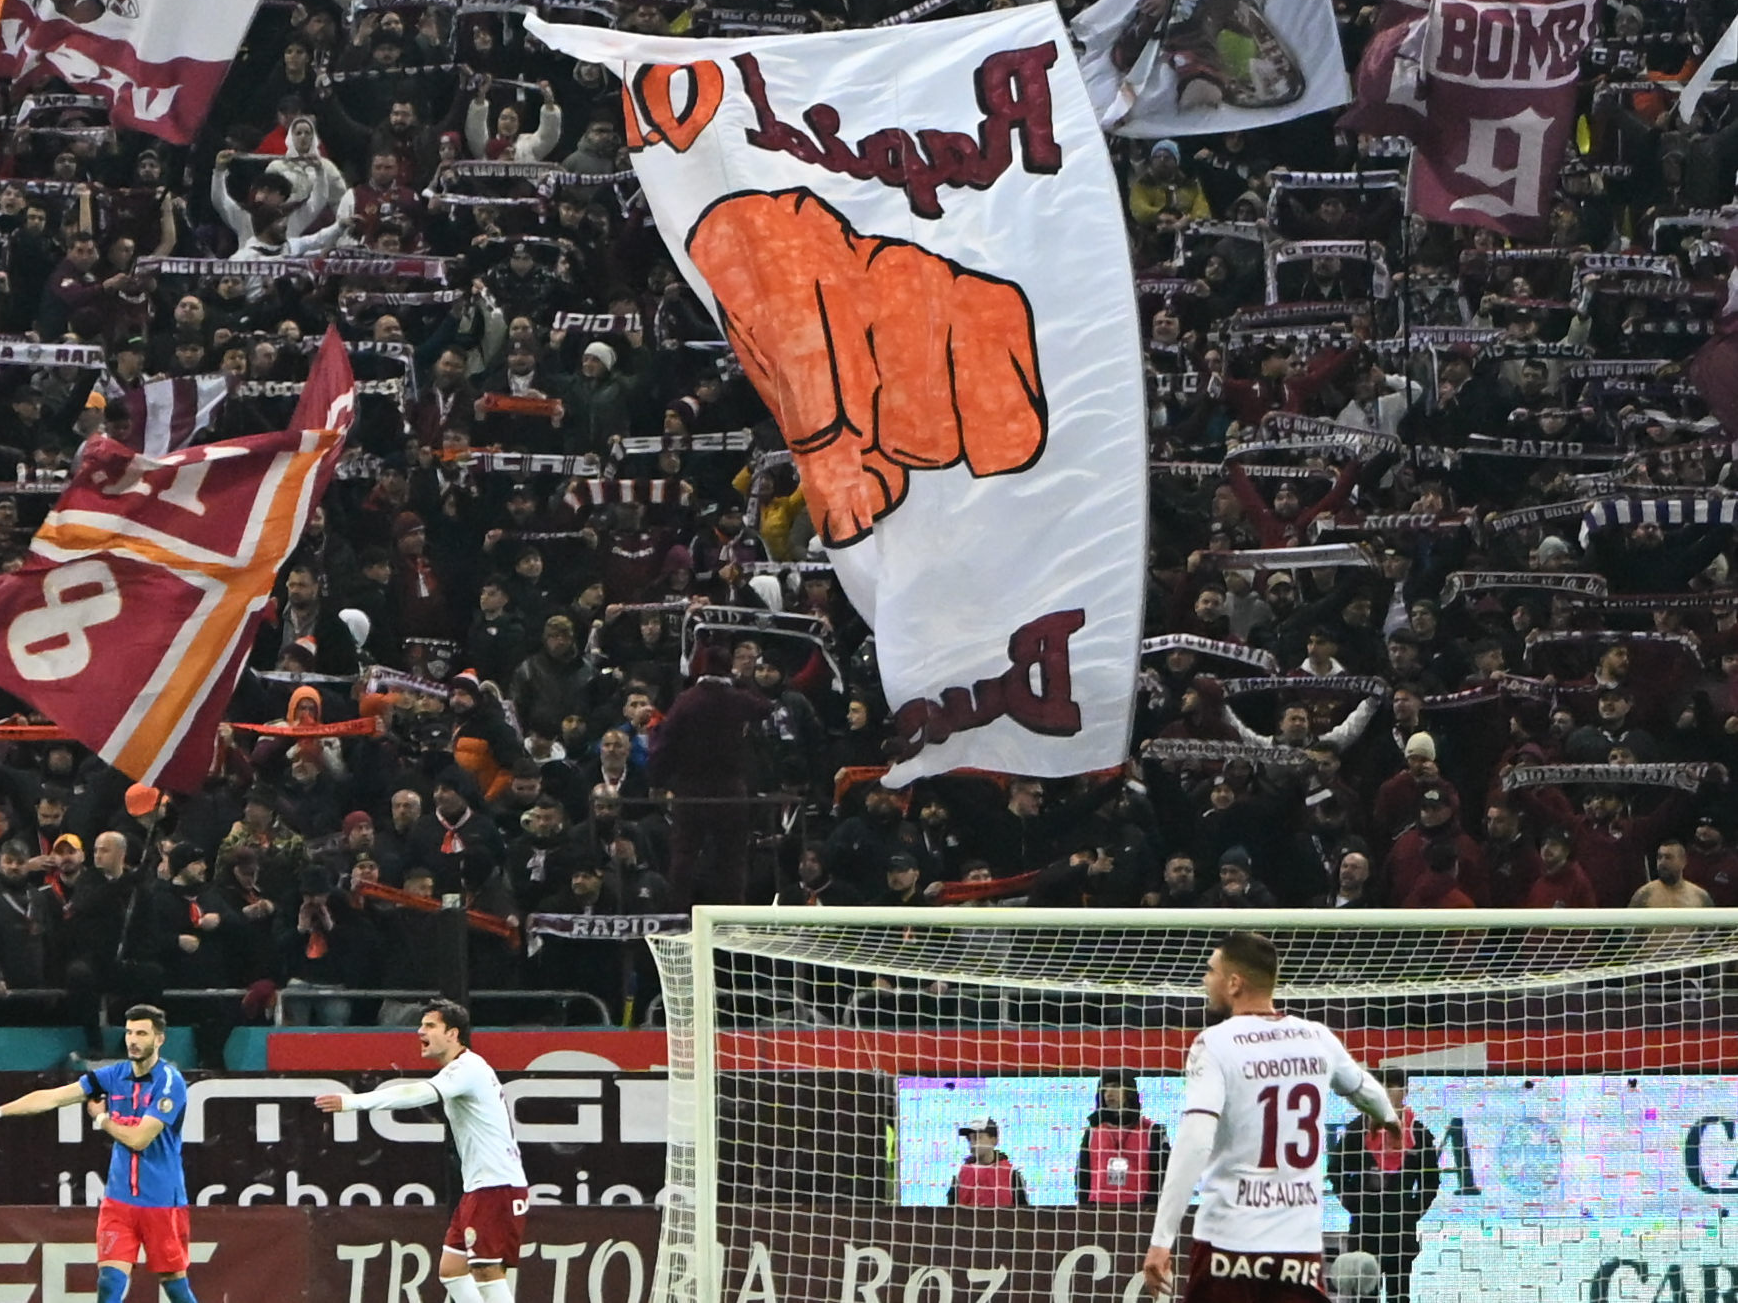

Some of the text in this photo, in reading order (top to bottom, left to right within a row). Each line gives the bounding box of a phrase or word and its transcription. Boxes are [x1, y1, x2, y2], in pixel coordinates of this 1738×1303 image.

[1501, 438, 1583, 456] RAPID
[1255, 1081, 1322, 1170] 13
[1209, 1251, 1275, 1281] DAC
